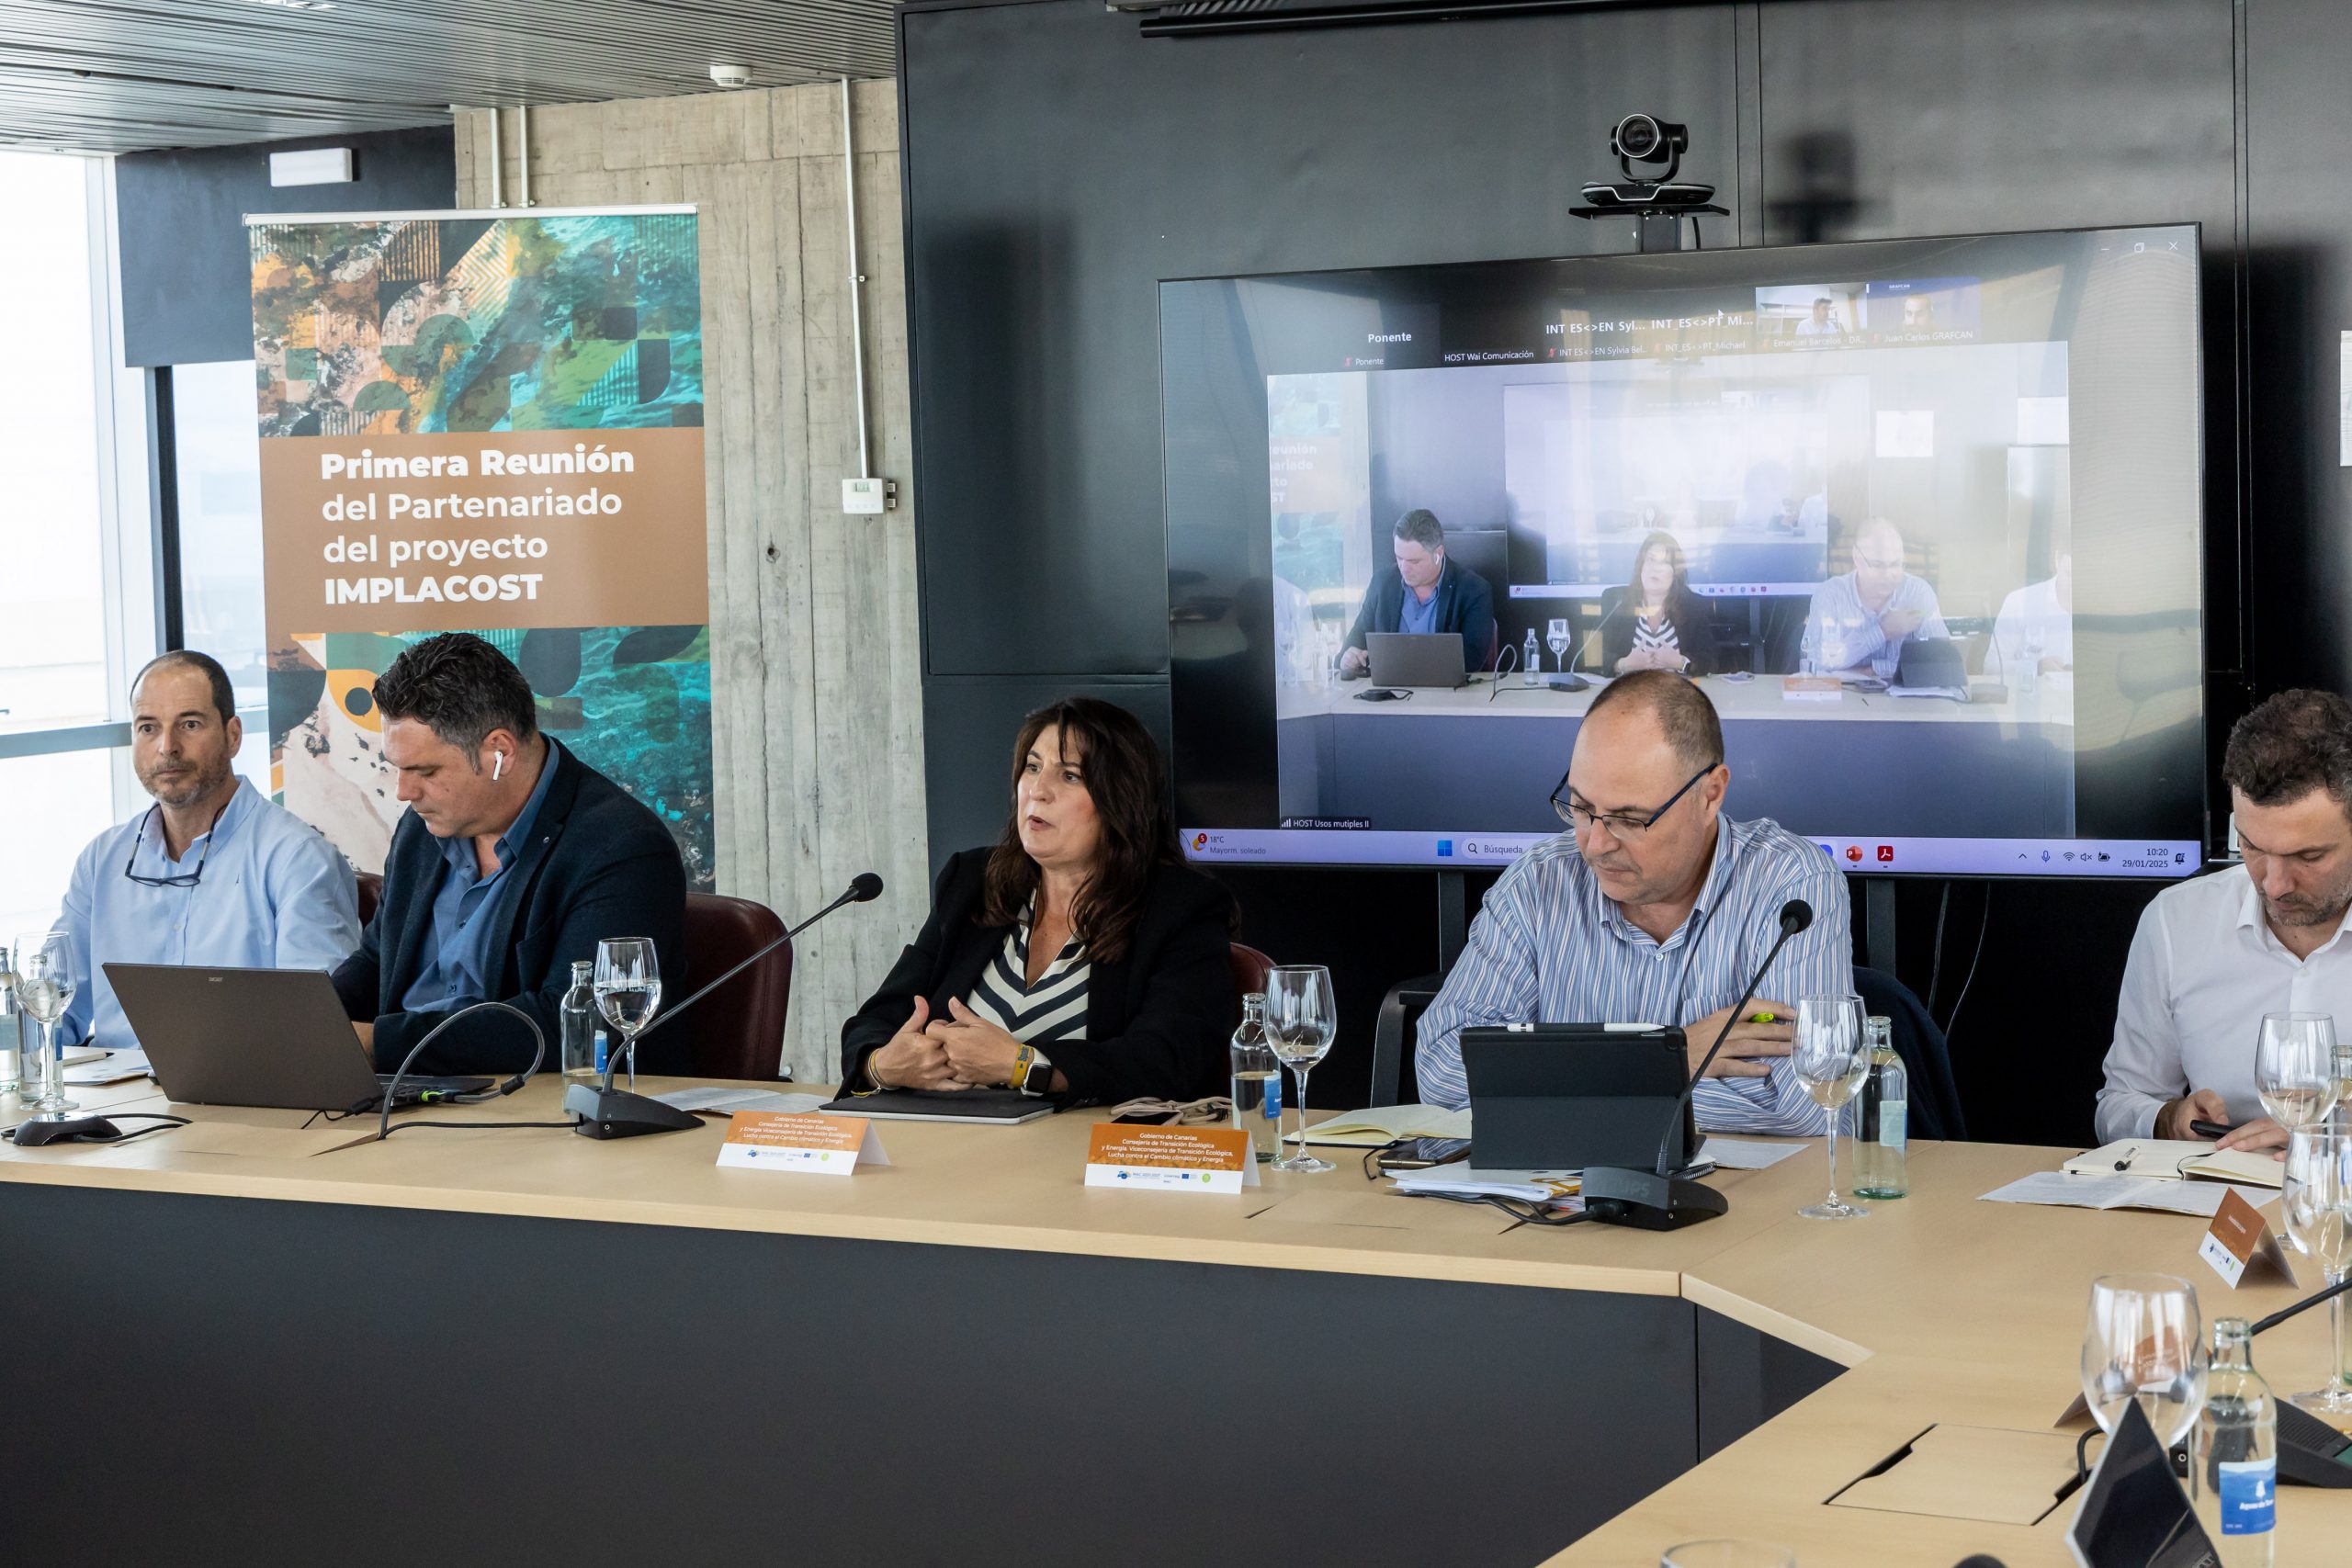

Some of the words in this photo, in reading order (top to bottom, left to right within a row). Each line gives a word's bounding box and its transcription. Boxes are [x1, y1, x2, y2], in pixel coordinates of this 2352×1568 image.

[1546, 324, 1566, 334] INT
[1367, 332, 1412, 344] Ponente
[1884, 334, 1904, 344] Juan
[1905, 332, 1930, 342] Carlos
[1932, 331, 1973, 341] GRAFCAN
[1444, 353, 1465, 362] HOST
[1467, 352, 1481, 361] Wai
[1482, 350, 1534, 361] Comunicación
[1607, 345, 1630, 356] Sylvia
[1355, 356, 1385, 367] Ponente
[321, 449, 469, 479] Primera
[481, 443, 634, 477] Reunión
[322, 493, 376, 522] del
[389, 488, 622, 521] Partenariado
[323, 535, 377, 563] del
[390, 533, 548, 568] proyecto
[325, 574, 543, 604] IMPLACOST
[1293, 819, 1314, 828] HOST
[1315, 819, 1332, 828] Usos
[1333, 819, 1363, 830] mutiples
[1240, 847, 1267, 855] soleado
[1484, 844, 1523, 855] Búsqueda
[2146, 848, 2169, 856] 10:20
[2121, 859, 2169, 868] 29/01/2025
